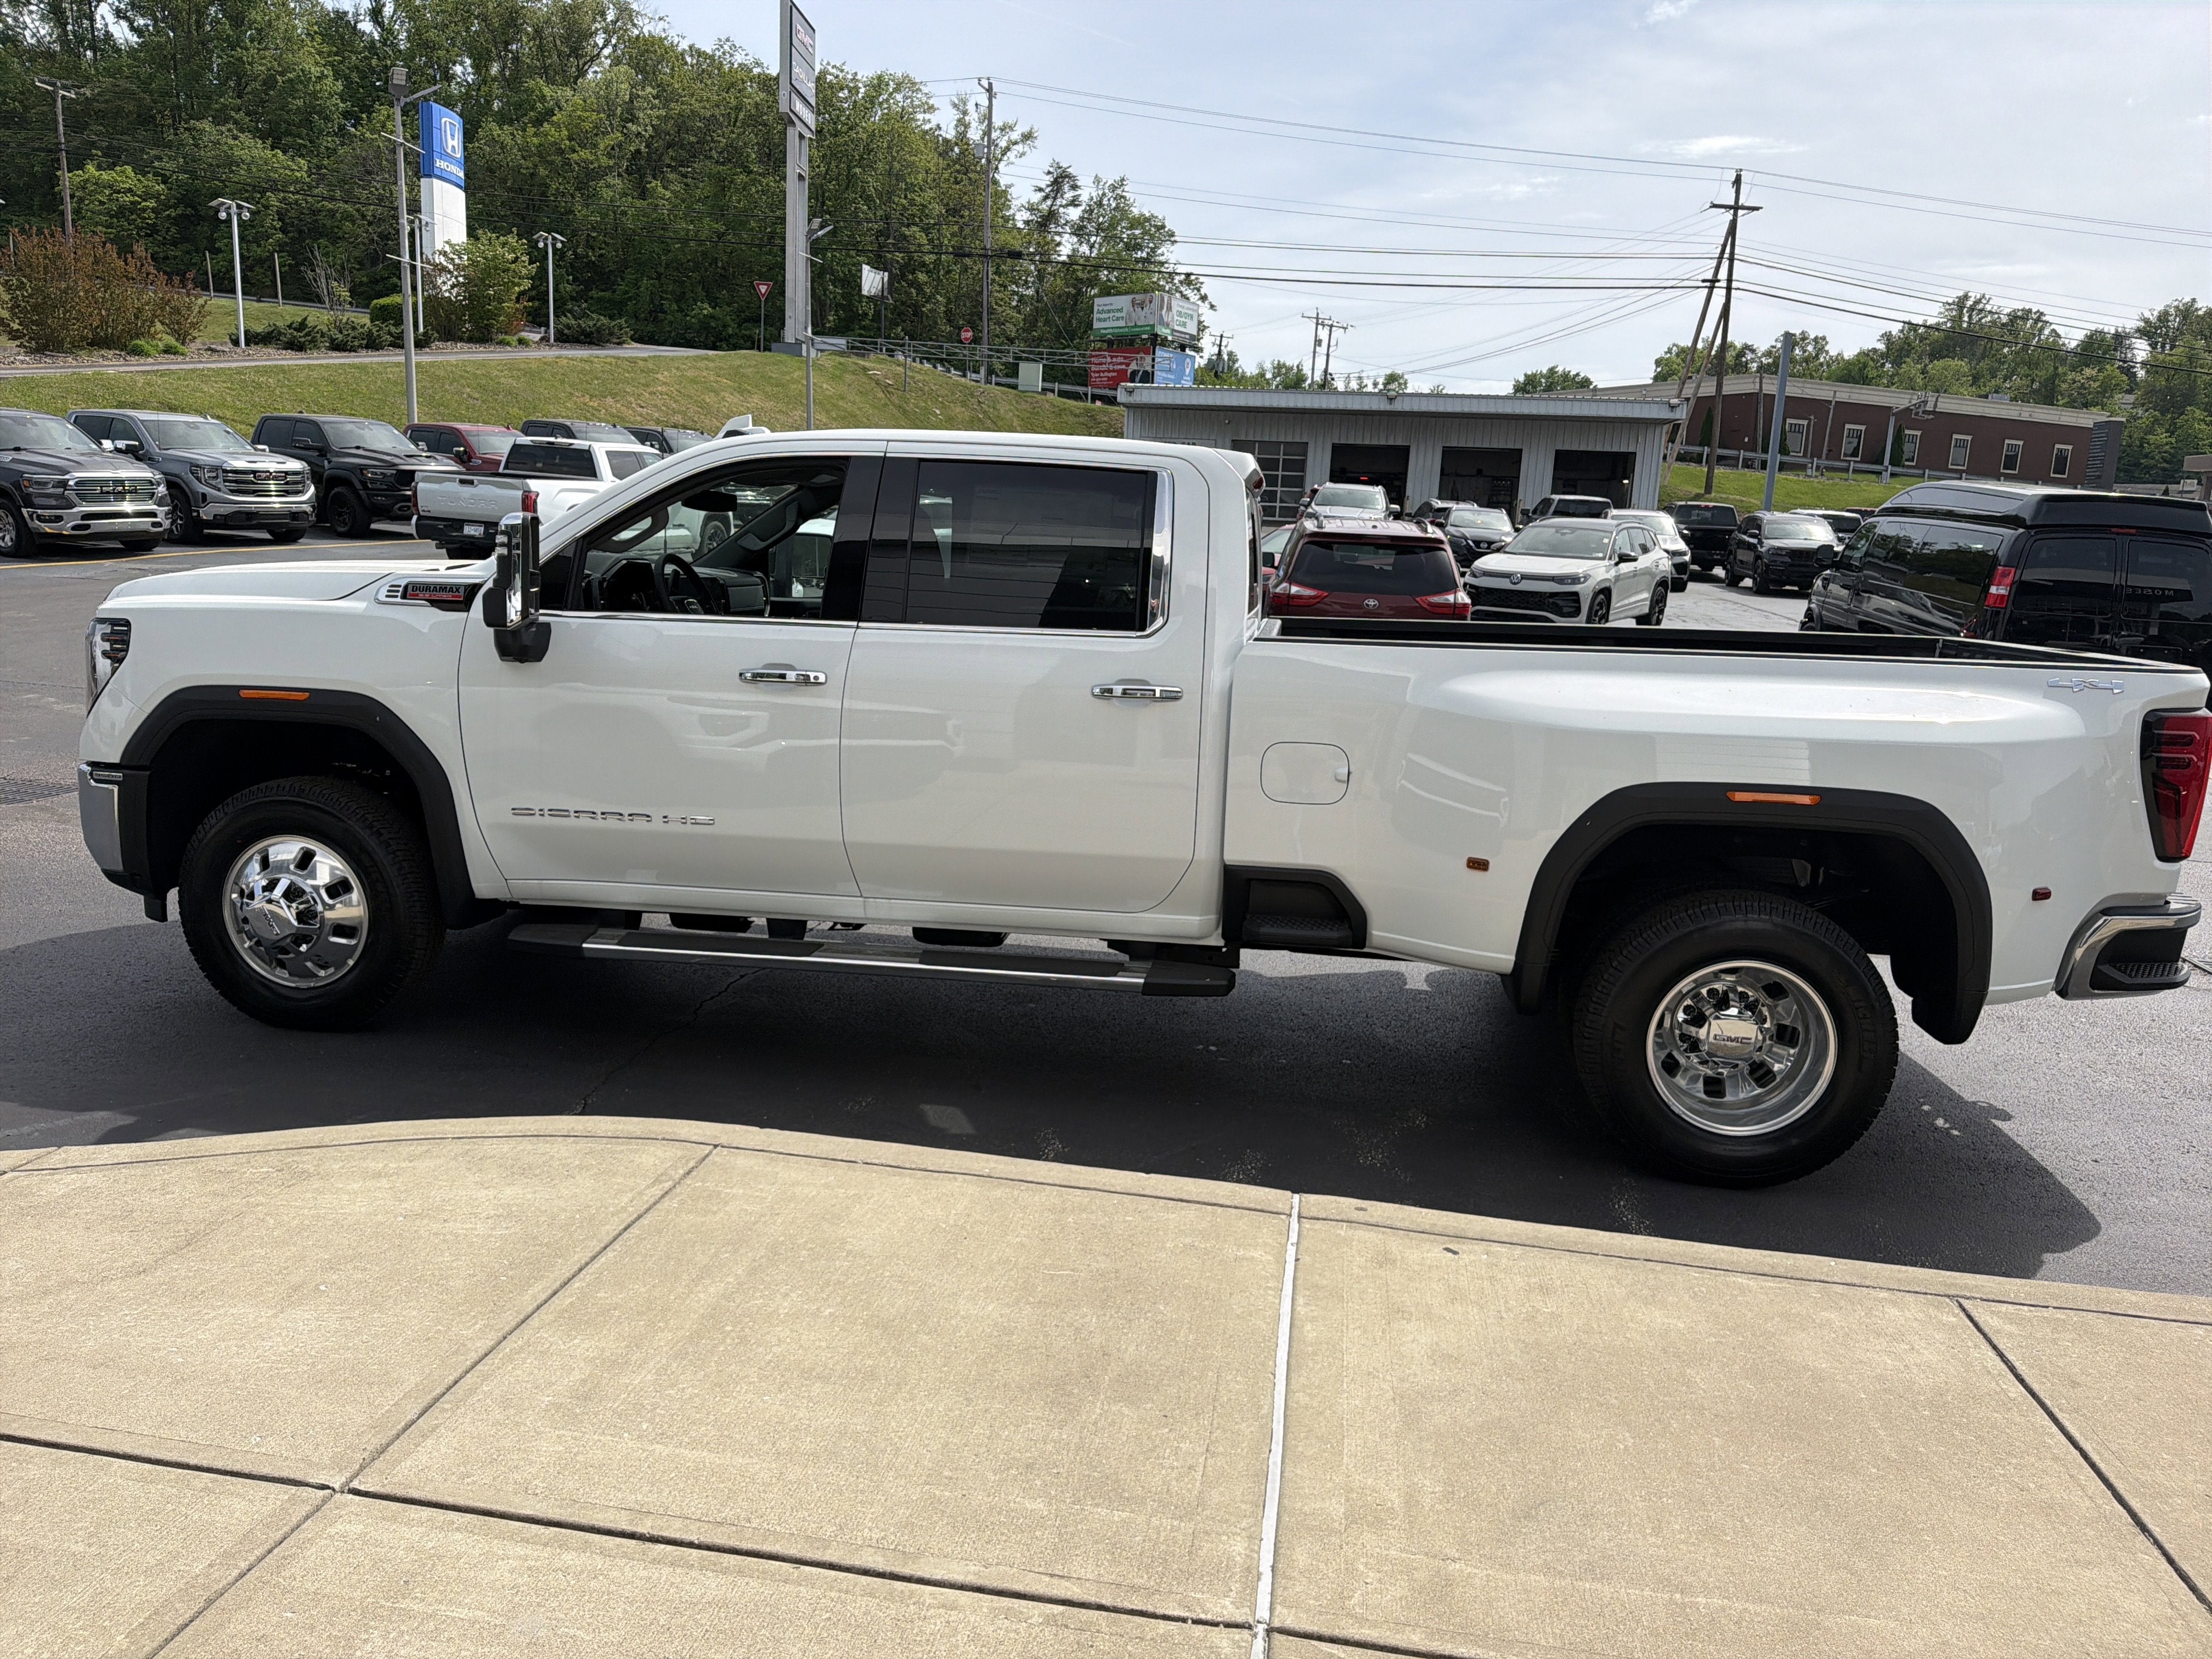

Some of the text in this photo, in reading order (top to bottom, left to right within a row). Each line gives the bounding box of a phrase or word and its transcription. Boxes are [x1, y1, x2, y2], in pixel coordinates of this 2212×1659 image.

[795, 23, 814, 55] GMC
[792, 61, 815, 93] CADILLAC
[795, 99, 811, 124] MOSES
[1096, 306, 1124, 314] Advanced
[1176, 309, 1194, 321] OB/GYN
[1175, 319, 1188, 329] CARE
[438, 495, 499, 509] TUNDRA
[411, 585, 461, 594] DURAMAX
[511, 806, 715, 825] SIERRA HD
[1712, 1033, 1753, 1045] GMC
